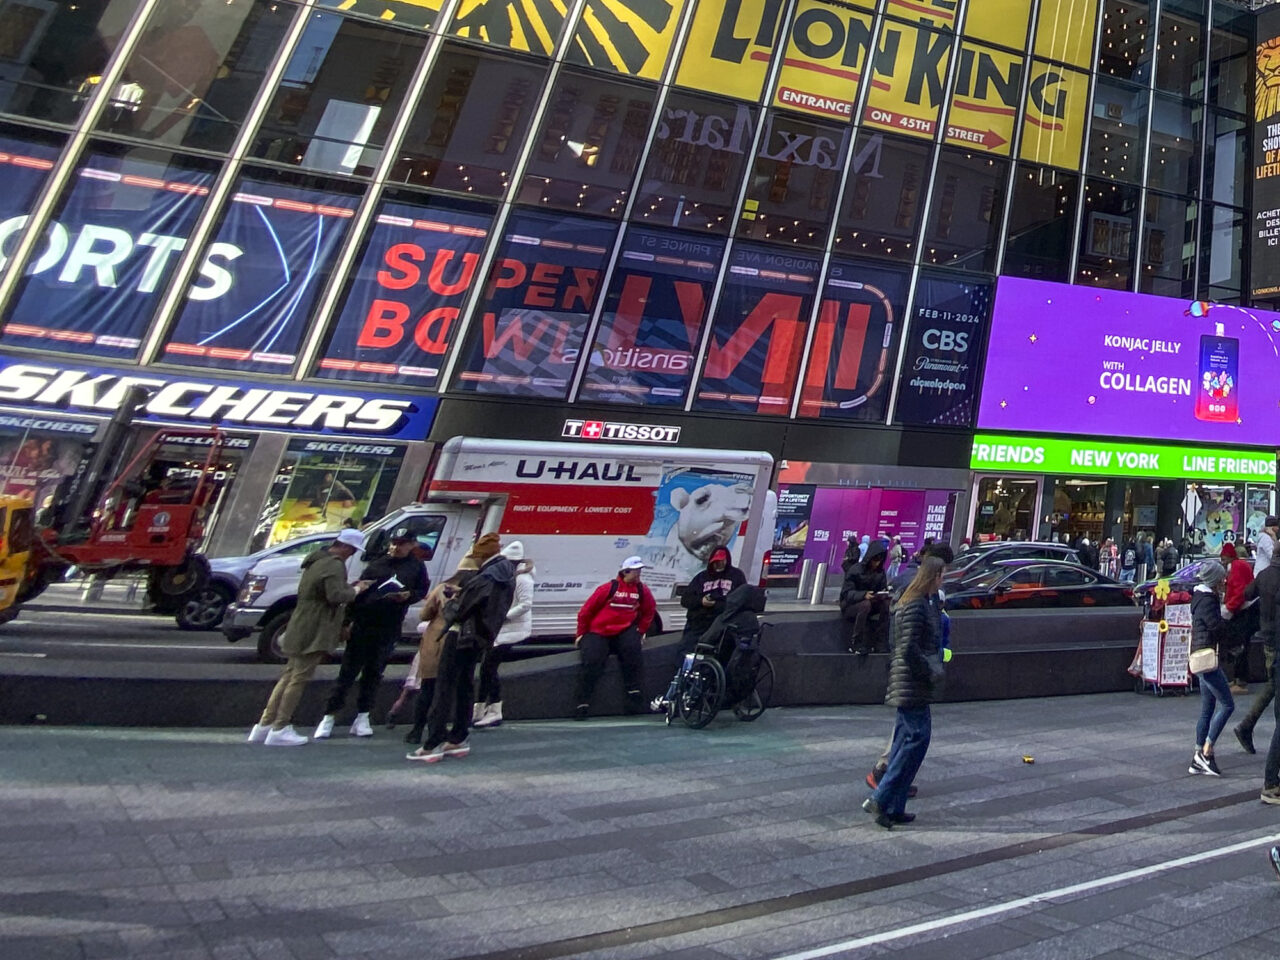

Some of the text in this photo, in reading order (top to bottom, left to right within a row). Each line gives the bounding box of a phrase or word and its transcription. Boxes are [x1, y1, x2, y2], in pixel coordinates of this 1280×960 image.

[905, 19, 1066, 119] KING
[782, 90, 985, 145] ENTRANCE ON 45TH STREET
[1265, 151, 1276, 163] OF
[1266, 218, 1280, 227] DES
[1268, 237, 1278, 246] ICI
[378, 242, 600, 312] SUPER
[356, 298, 577, 367] BOWL
[922, 328, 969, 353] CBS
[1104, 335, 1181, 354] KONJAC JELLY
[912, 355, 969, 373] Paramount+
[1103, 360, 1125, 371] WITH
[909, 376, 966, 391] nickelodeon
[1099, 371, 1192, 396] COLLAGEN
[0, 363, 416, 436] SKECHERS
[568, 422, 679, 442] T TISSOT
[304, 441, 397, 455] SKECHERS
[516, 460, 642, 482] U-HAUL
[1070, 449, 1112, 468] NEW
[1116, 451, 1160, 470] YORK
[1183, 455, 1216, 472] LINE
[1218, 456, 1277, 474] FRIENDS
[513, 504, 535, 513] RIGHT
[537, 505, 579, 514] EQUIPMENT
[584, 506, 613, 514] LOWEST
[613, 506, 632, 514] COST
[925, 522, 944, 531] SPACE
